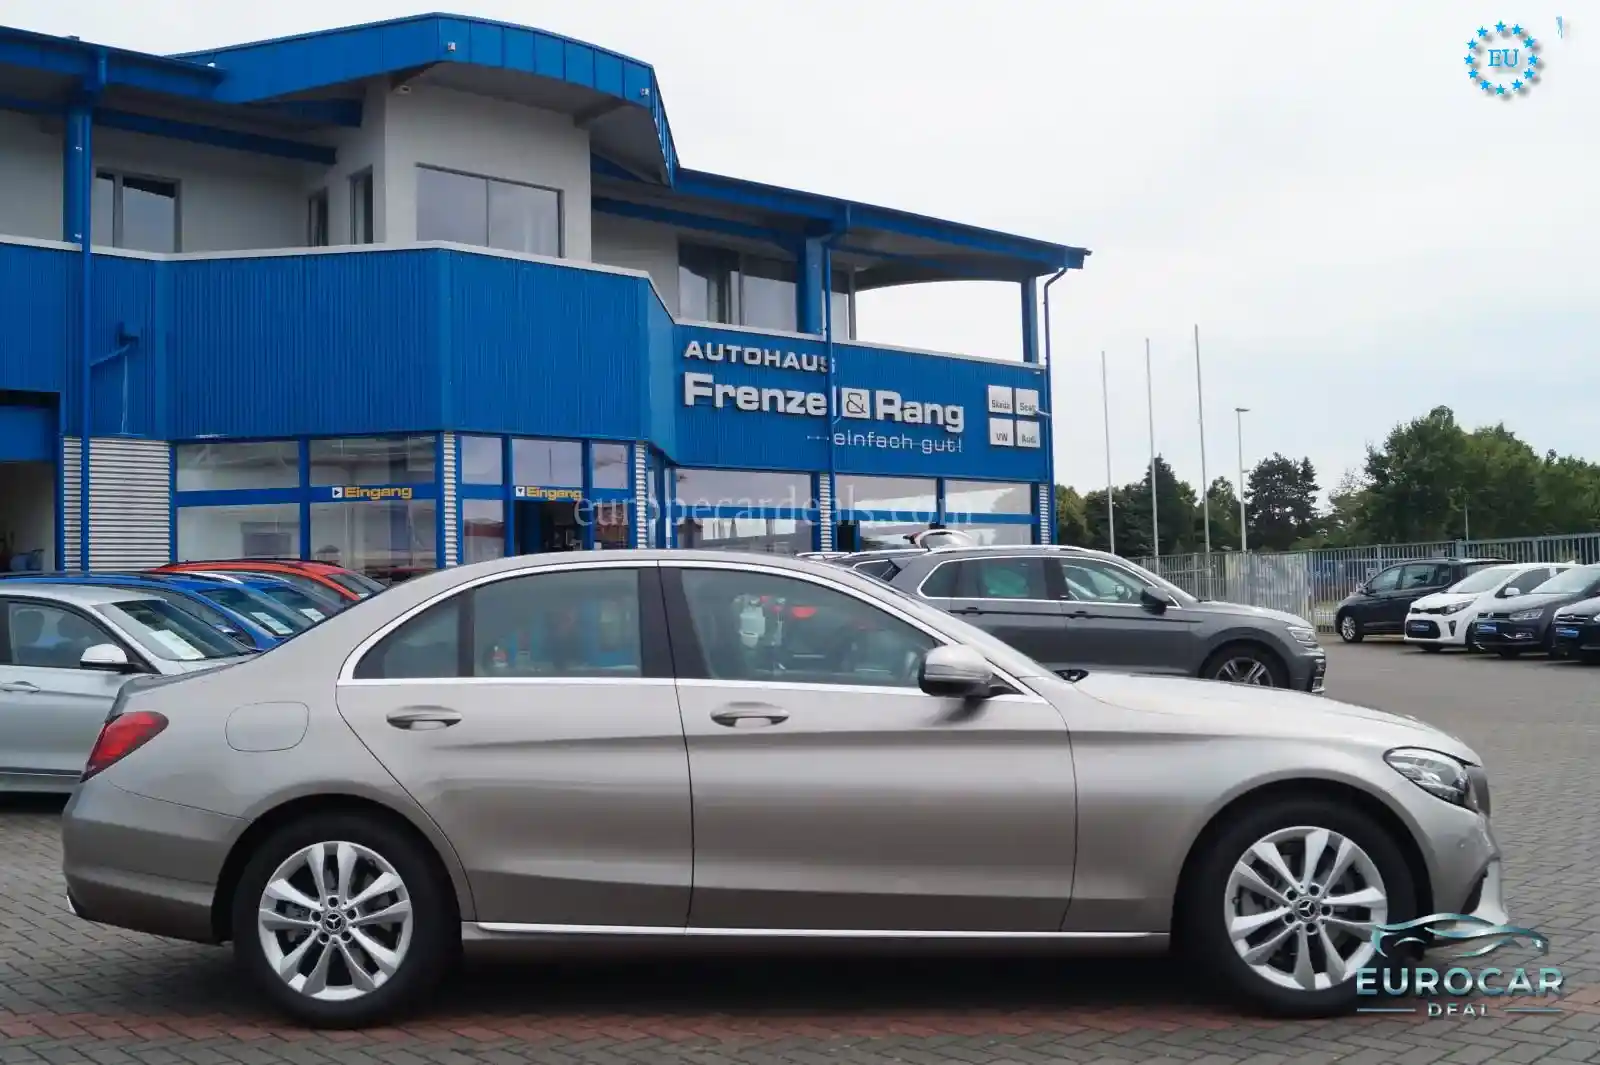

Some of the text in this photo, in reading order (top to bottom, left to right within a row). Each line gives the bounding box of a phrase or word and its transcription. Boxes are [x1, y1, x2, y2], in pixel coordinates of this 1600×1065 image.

[684, 340, 836, 373] AUTOHAUS
[684, 371, 837, 416] Frenzel
[875, 390, 965, 433] Rang
[996, 432, 1008, 442] VW
[921, 437, 963, 455] gut!
[344, 486, 413, 501] Eingang
[526, 486, 583, 501] Eingang
